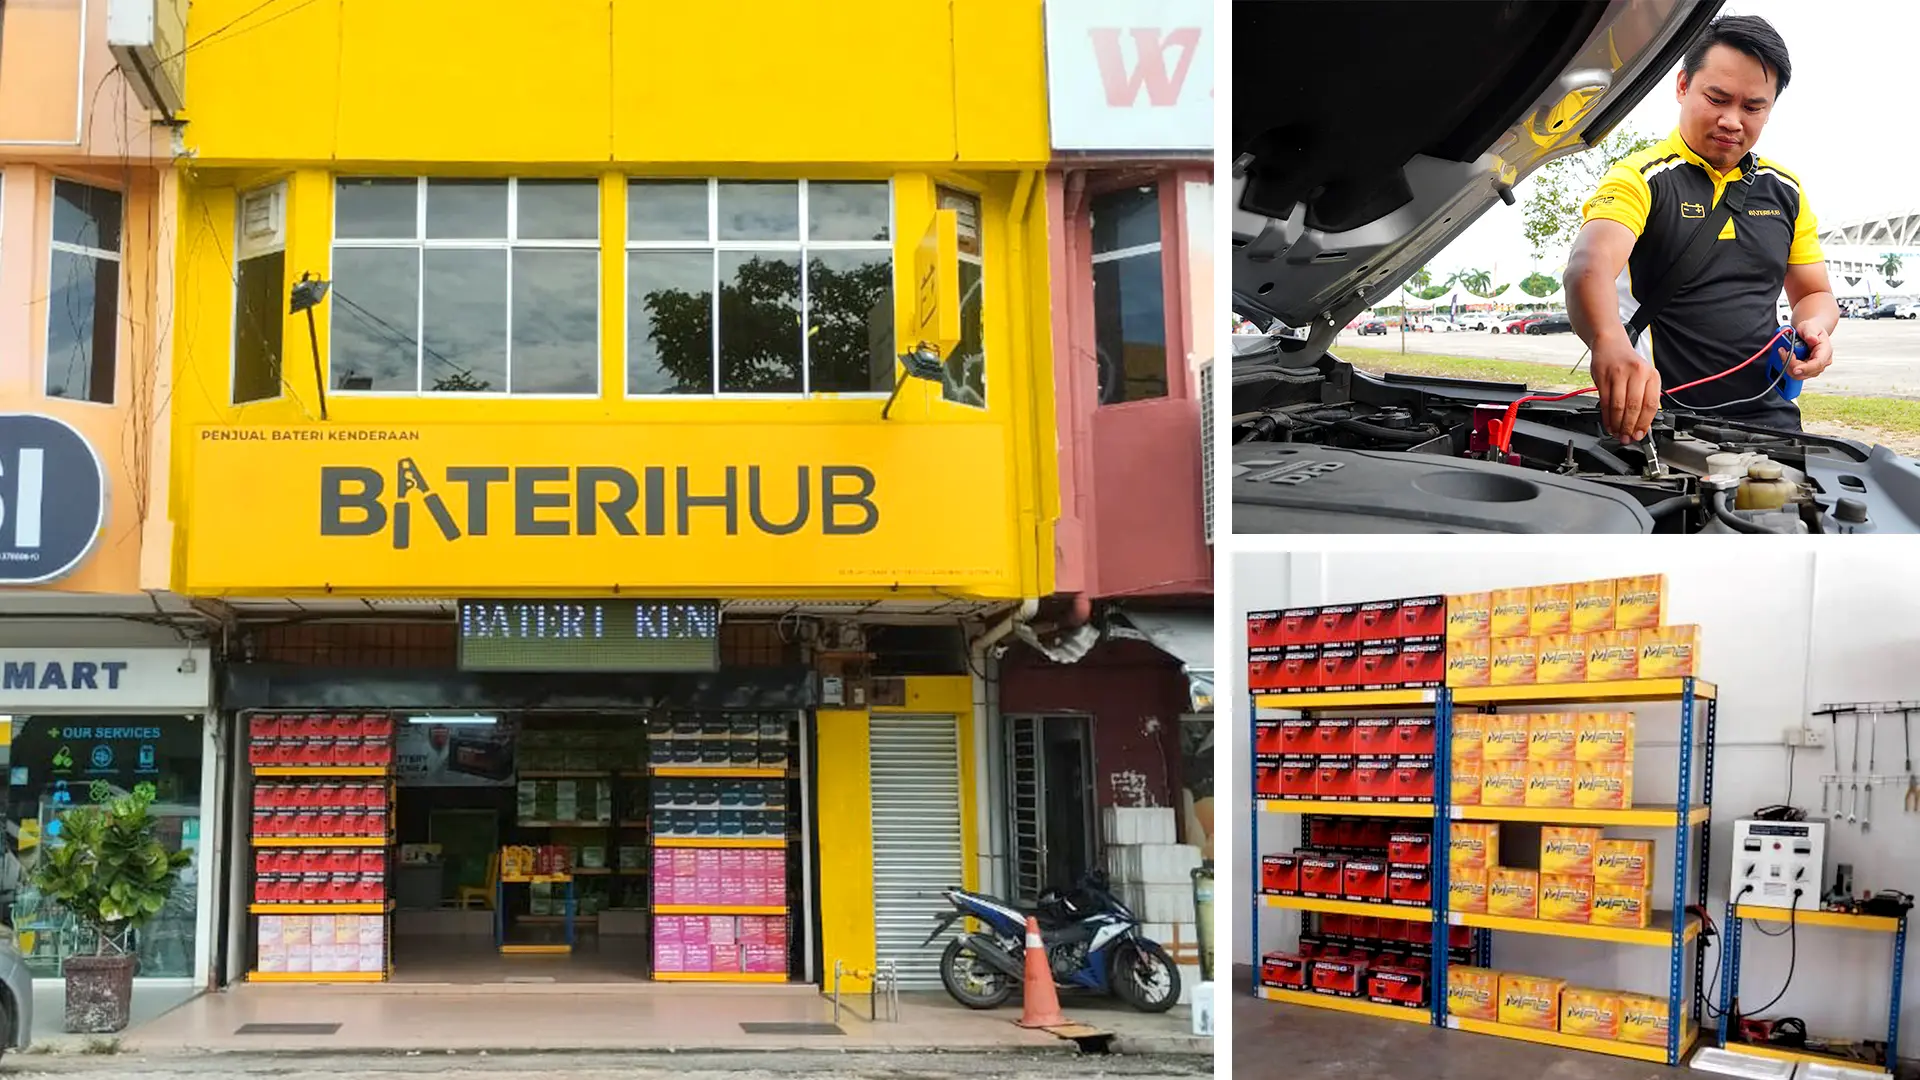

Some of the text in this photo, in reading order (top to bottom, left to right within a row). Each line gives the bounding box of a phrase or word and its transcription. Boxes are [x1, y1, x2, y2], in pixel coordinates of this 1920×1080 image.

[1087, 27, 1213, 107] W
[201, 430, 419, 441] PENJUAL BATERI KENDERAAN
[463, 604, 716, 638] BATERI KEN
[3, 661, 127, 690] MART
[62, 727, 161, 739] OUR SERVICES
